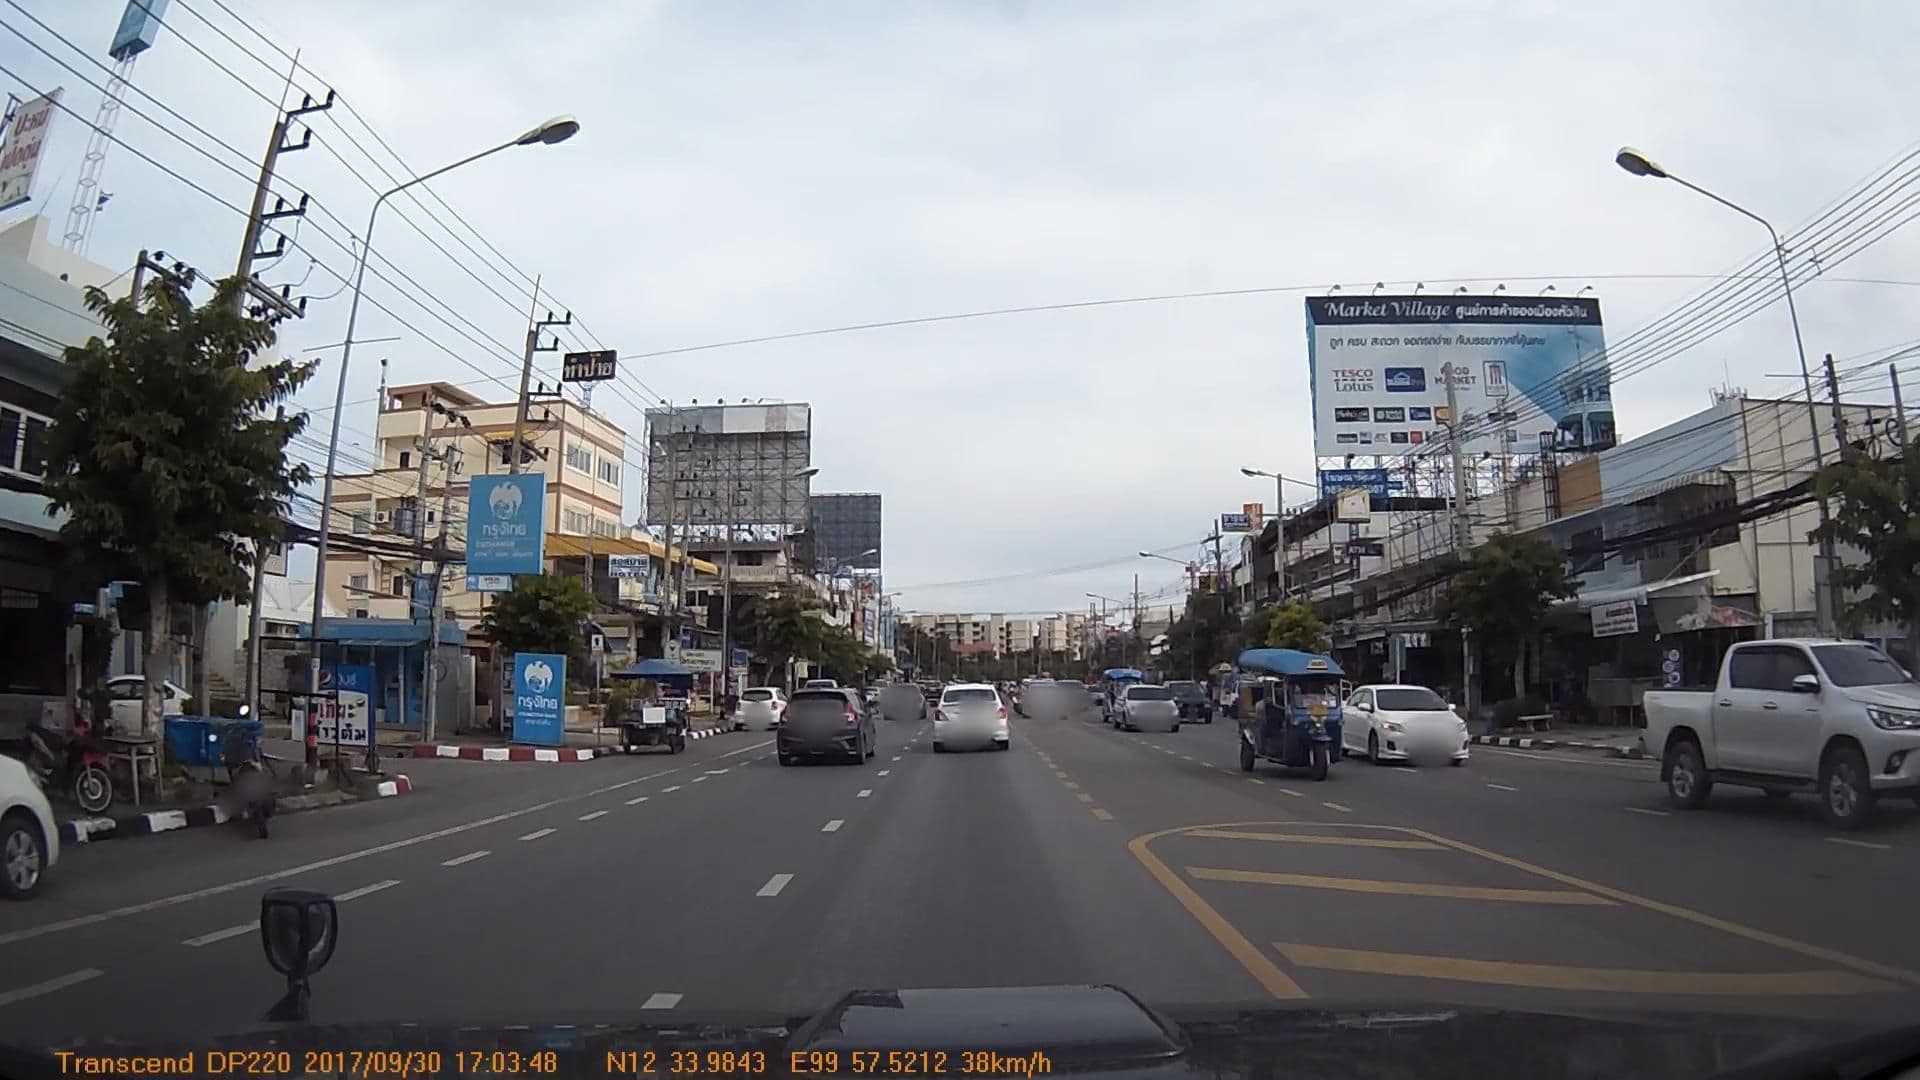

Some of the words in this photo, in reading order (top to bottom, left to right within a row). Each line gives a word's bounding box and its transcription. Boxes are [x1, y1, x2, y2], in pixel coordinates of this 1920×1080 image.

[1324, 301, 1387, 317] Market
[1391, 301, 1450, 320] Village
[564, 353, 612, 378] ทำป้าย
[1332, 369, 1374, 378] TESCO
[1335, 381, 1374, 392] Lotus
[482, 521, 528, 540] กรุงไทย
[518, 695, 559, 711] กรุงไทย
